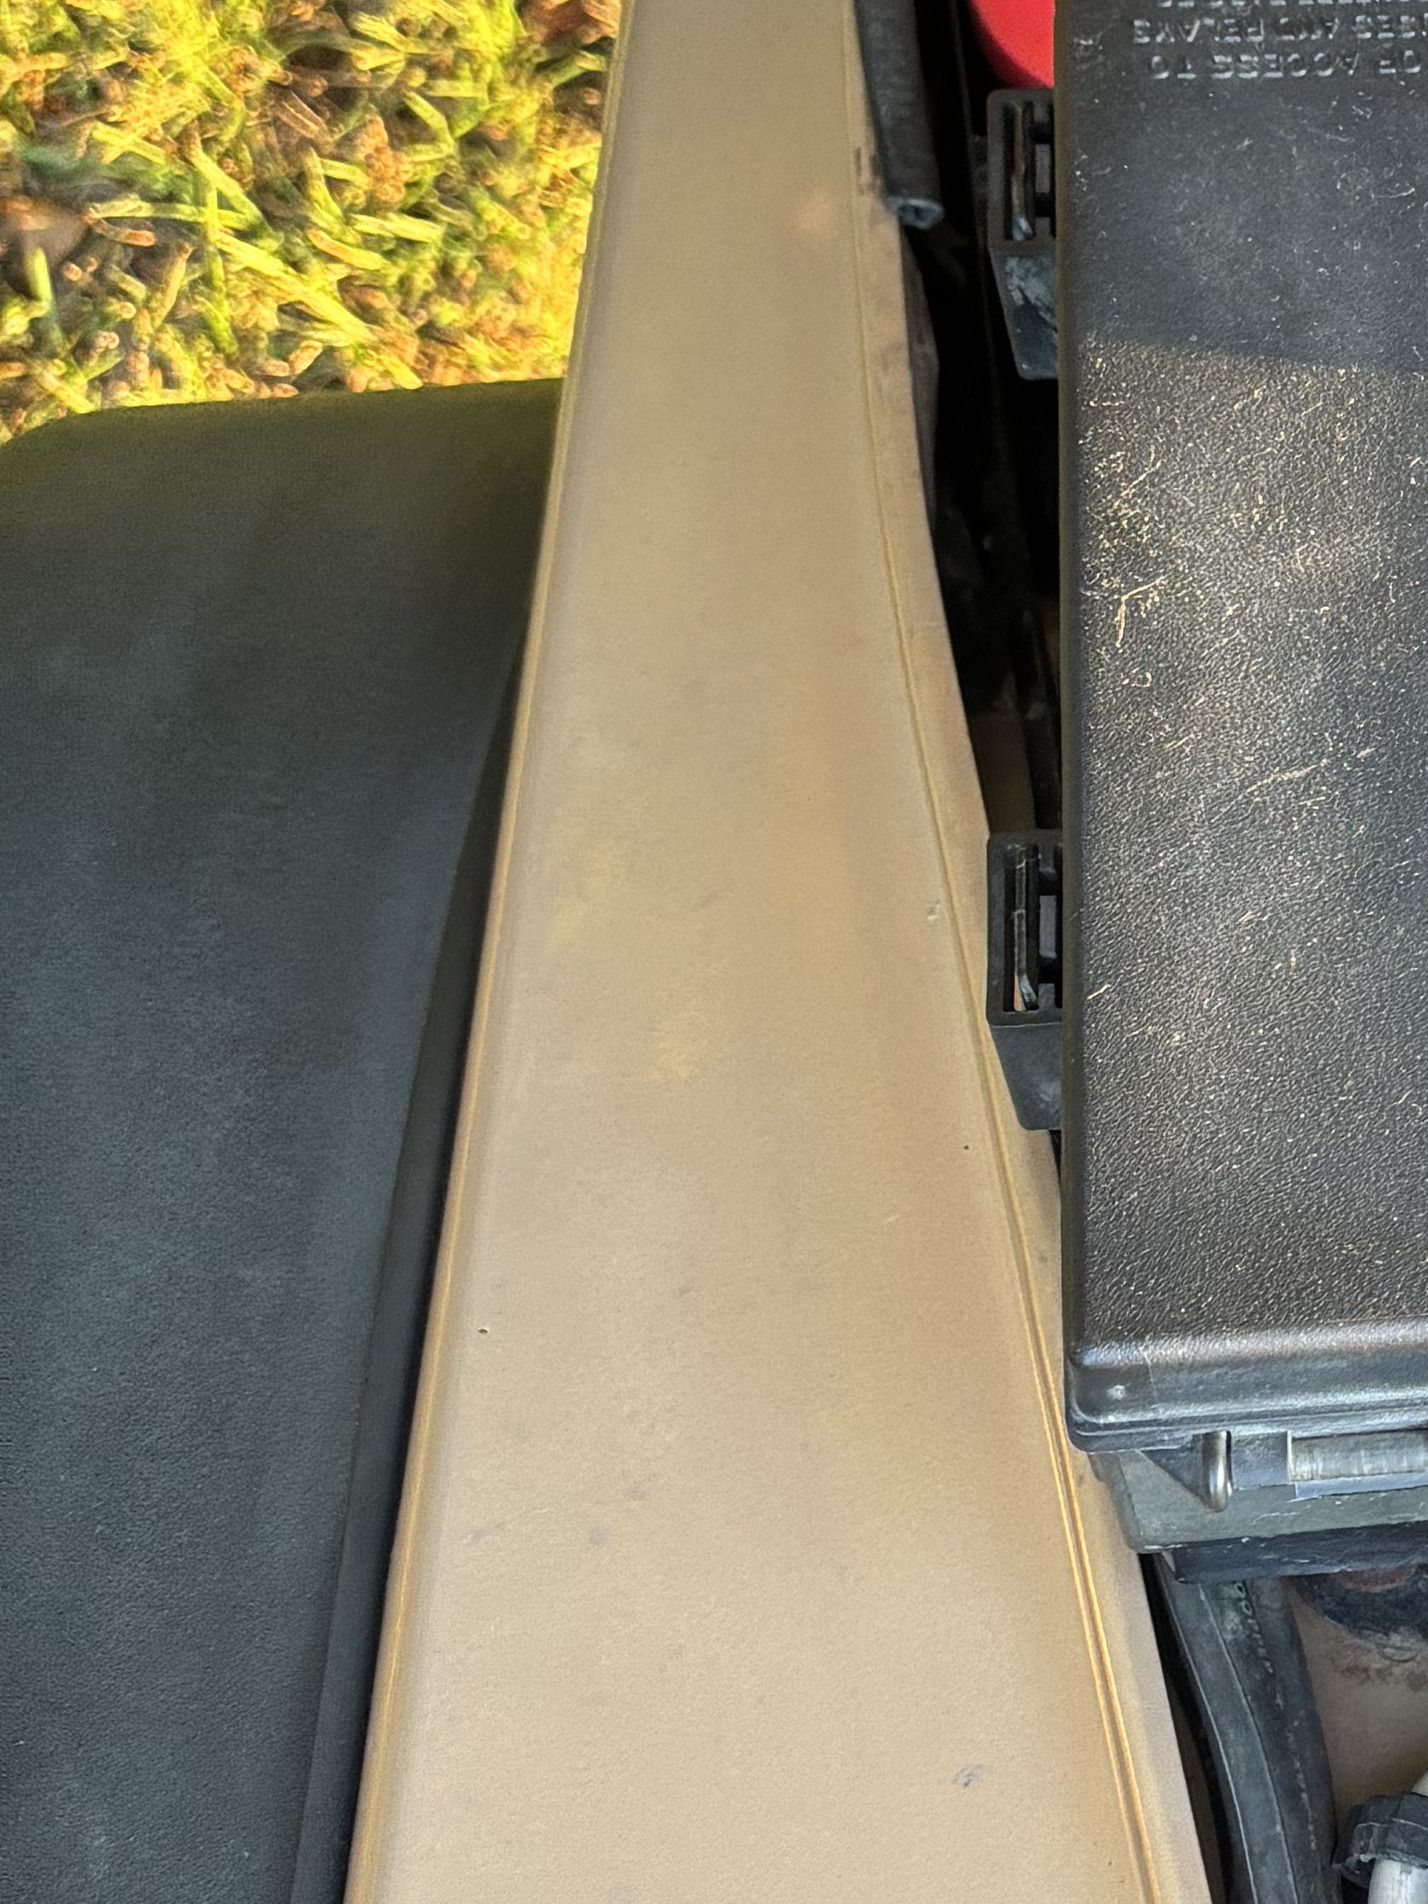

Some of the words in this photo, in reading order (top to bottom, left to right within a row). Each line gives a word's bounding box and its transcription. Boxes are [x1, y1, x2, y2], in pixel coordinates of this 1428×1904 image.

[1131, 17, 1267, 44] RELAYS
[1279, 15, 1341, 42] AND
[1151, 54, 1197, 80] TO
[1212, 51, 1360, 79] ACCESS
